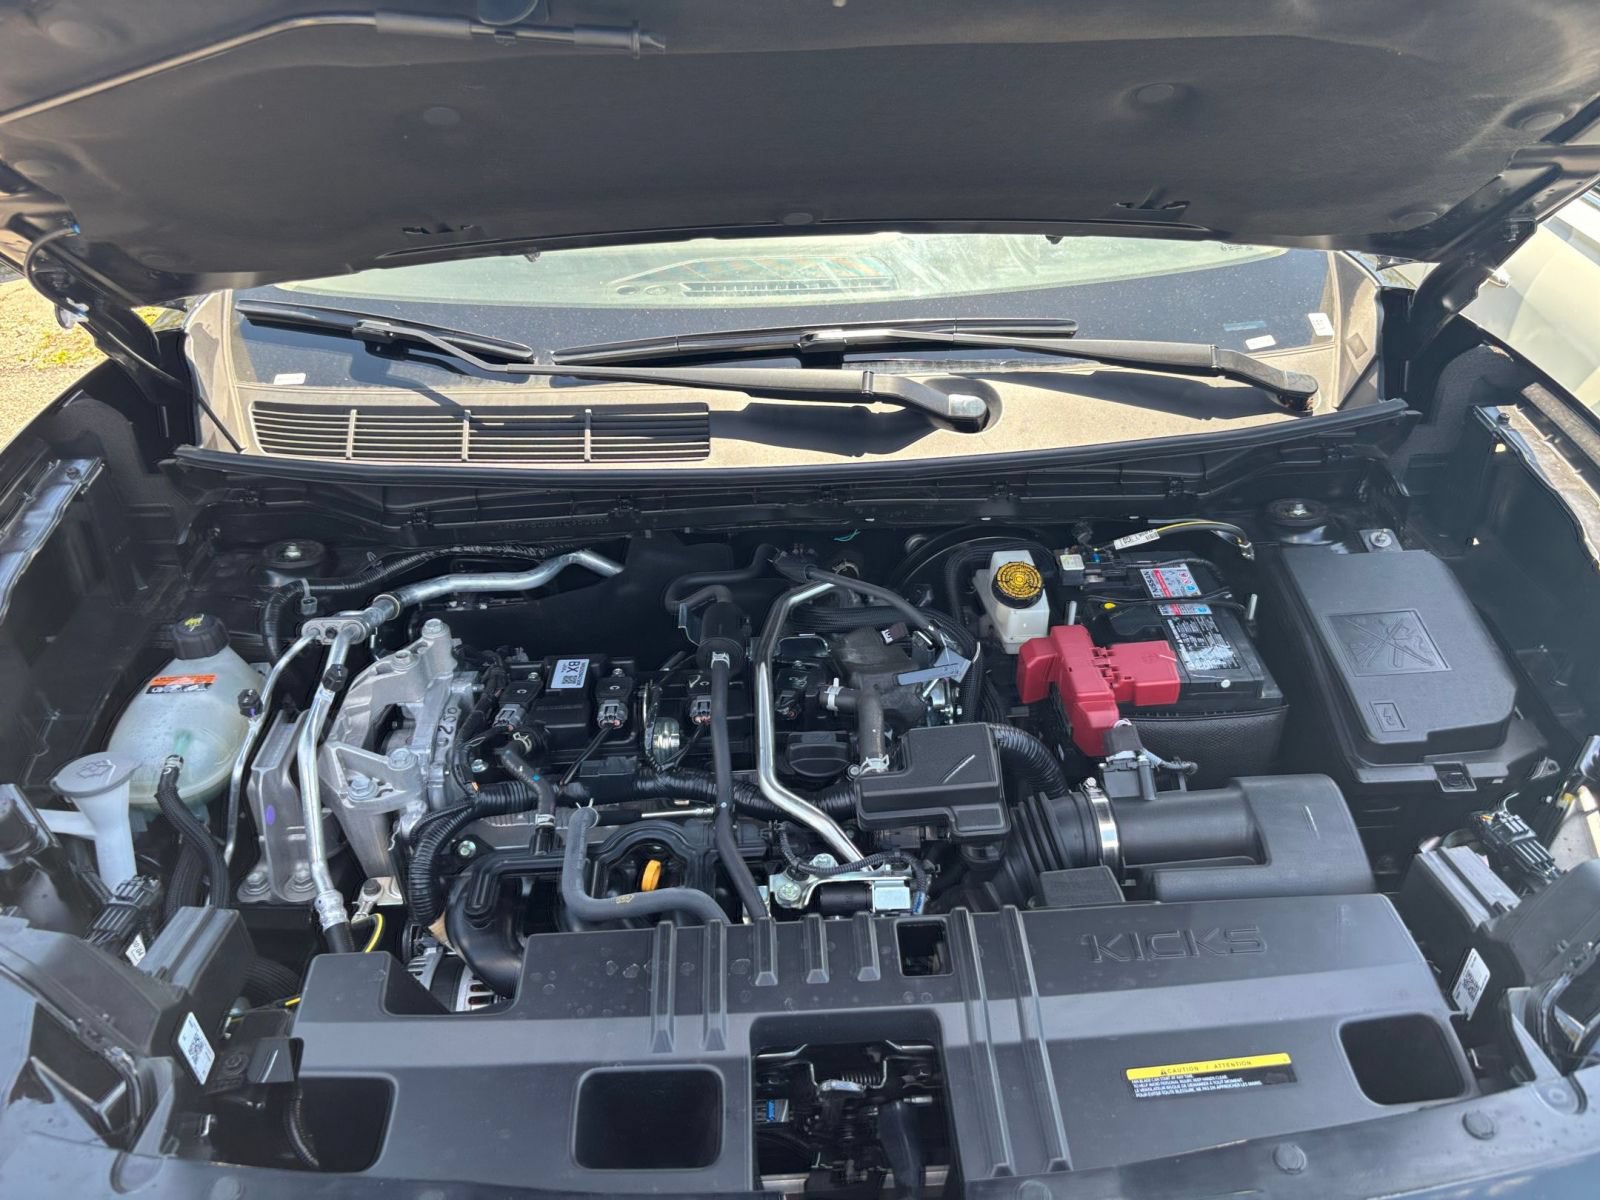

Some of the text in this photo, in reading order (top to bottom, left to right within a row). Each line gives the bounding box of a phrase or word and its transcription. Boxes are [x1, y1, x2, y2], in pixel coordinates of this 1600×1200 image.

[567, 661, 580, 673] BX
[1086, 926, 1268, 963] KICKS
[1167, 1066, 1199, 1074] CAUTION
[1213, 1061, 1252, 1069] ATTENTION
